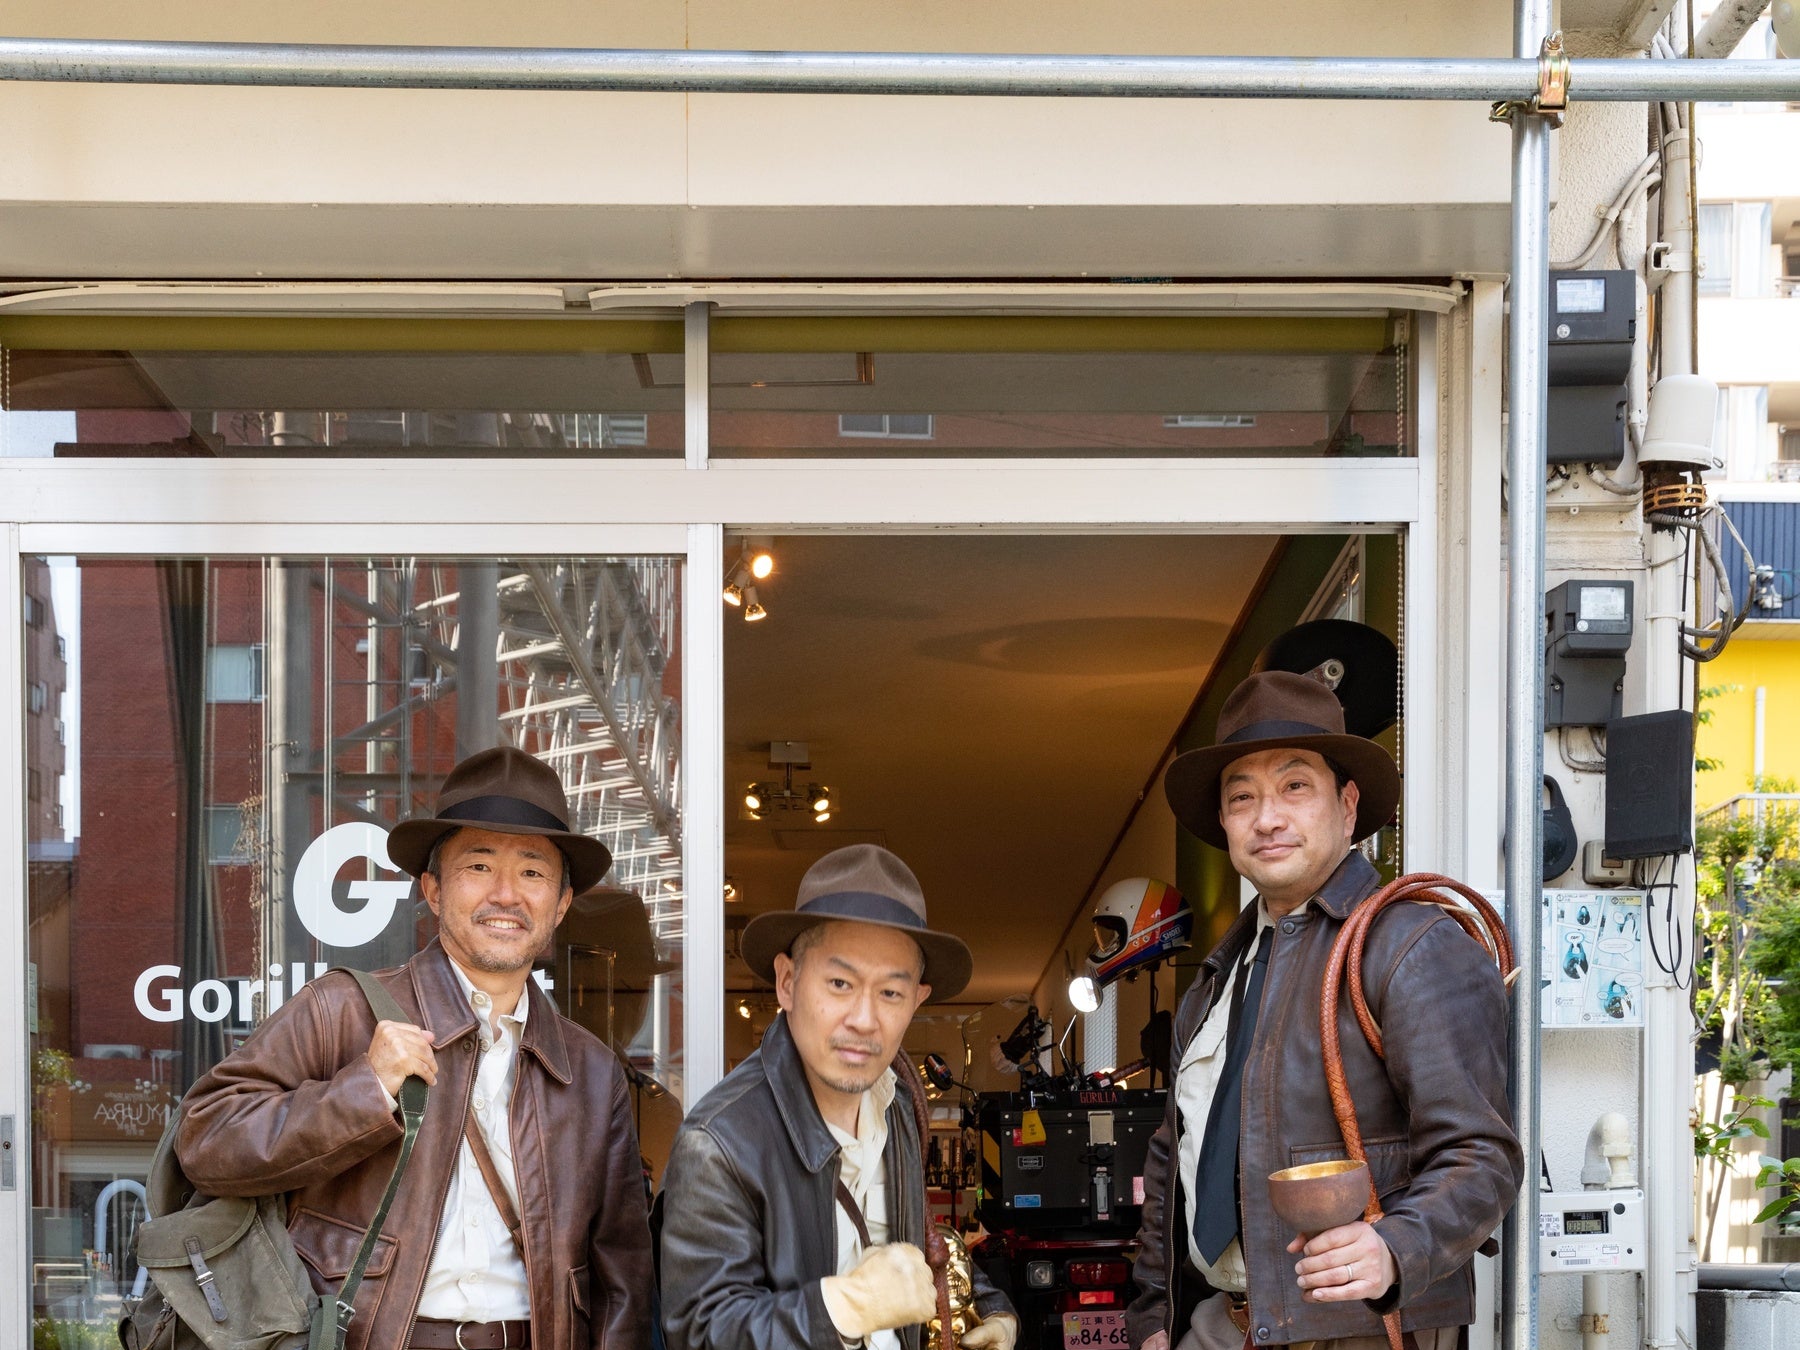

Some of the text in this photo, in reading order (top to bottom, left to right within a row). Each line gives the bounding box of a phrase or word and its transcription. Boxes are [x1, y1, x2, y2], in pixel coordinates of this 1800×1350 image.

[293, 821, 412, 948] G
[133, 962, 328, 1023] Goril
[1080, 1091, 1118, 1103] GORILLA
[1081, 1316, 1116, 1326] 江東区
